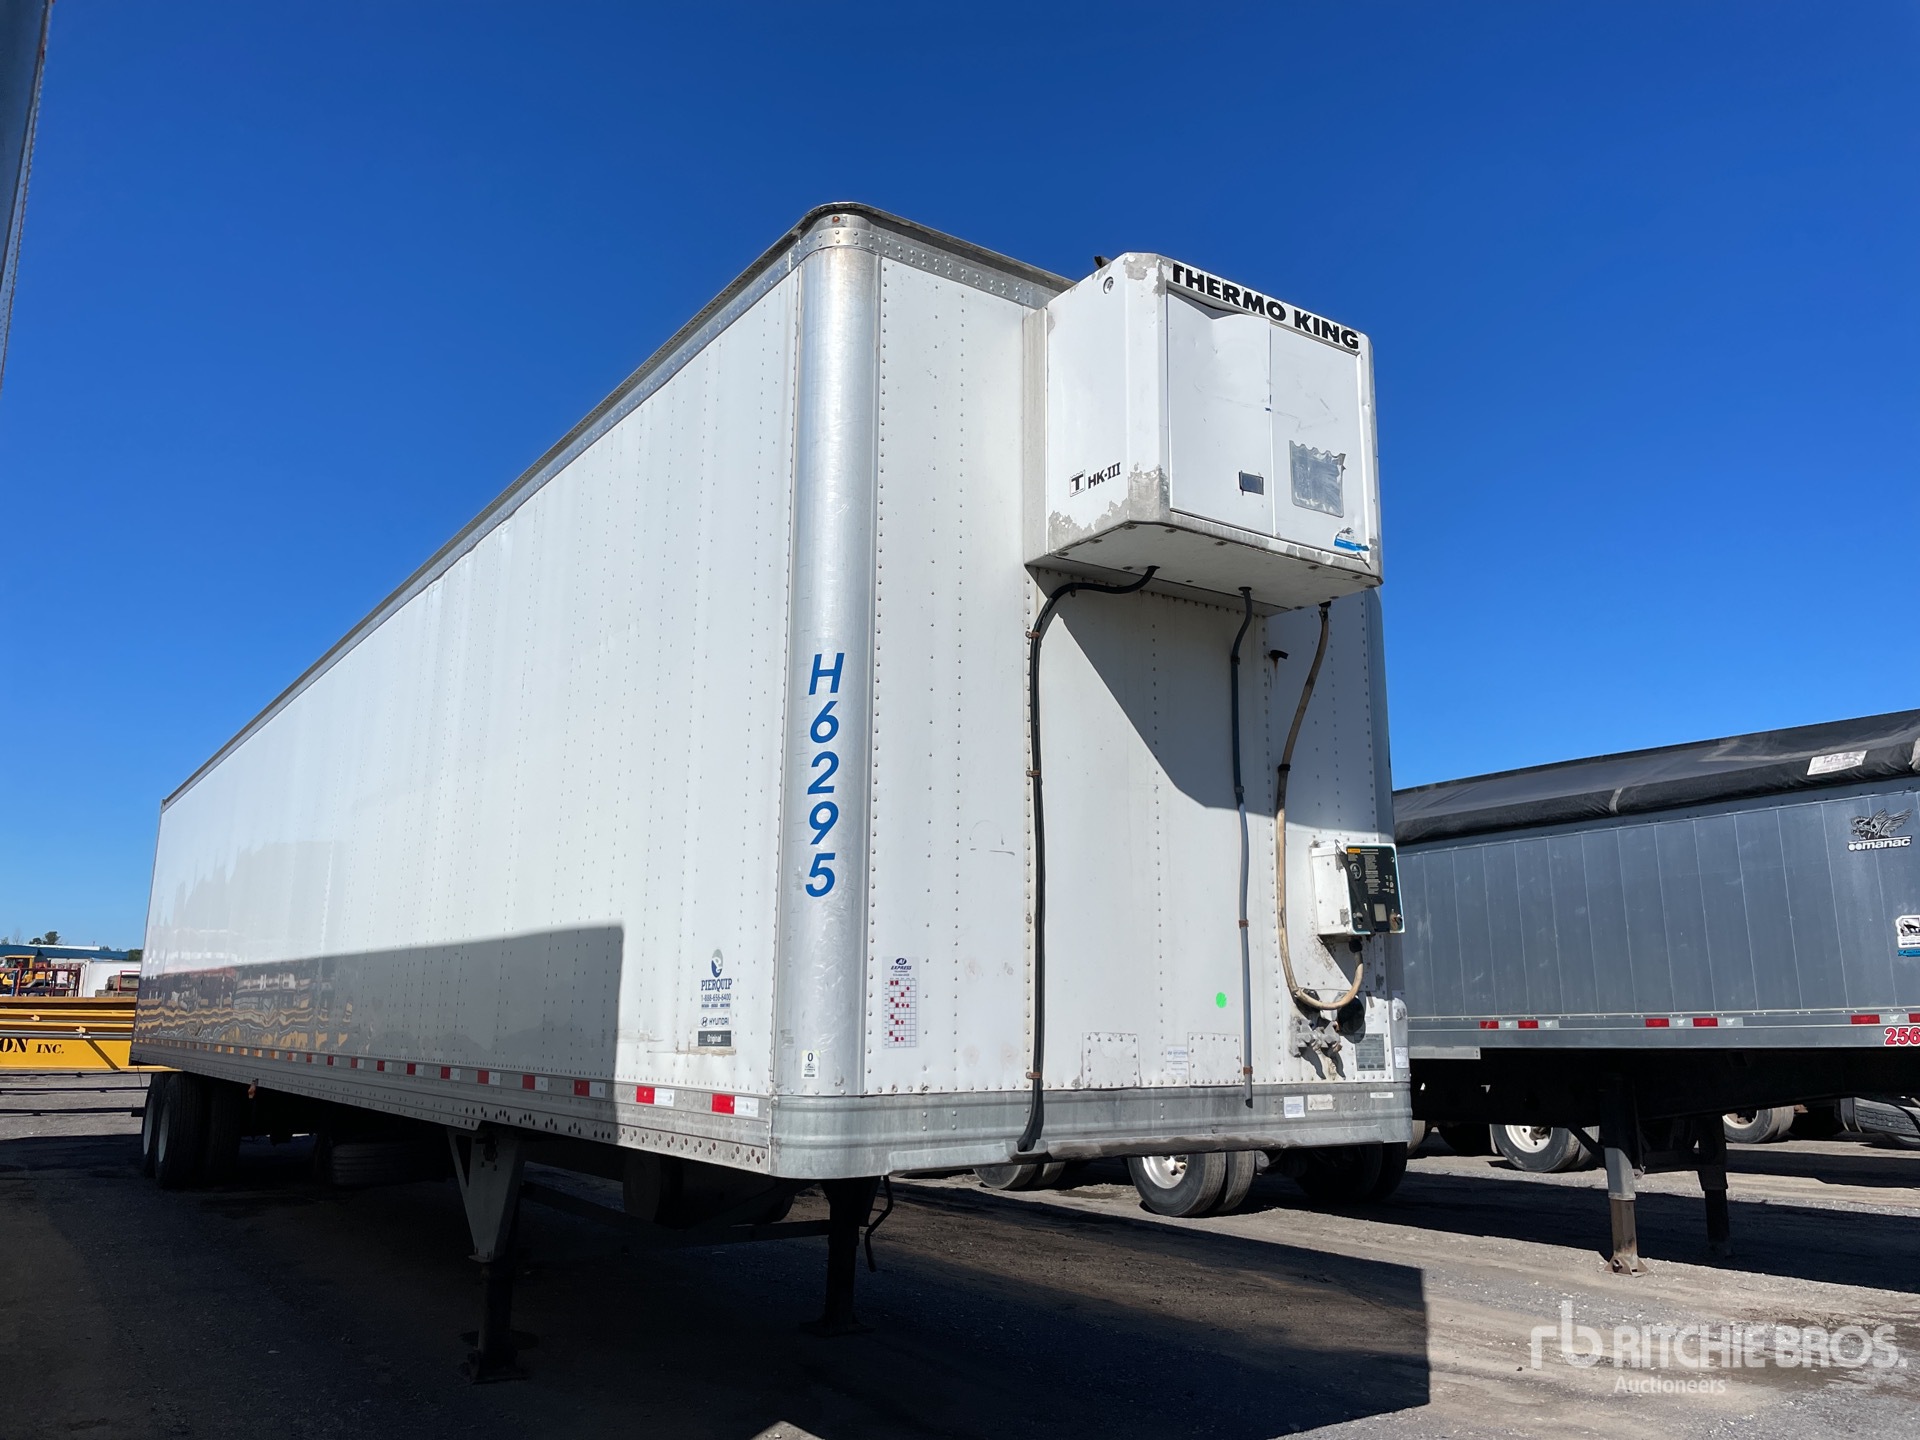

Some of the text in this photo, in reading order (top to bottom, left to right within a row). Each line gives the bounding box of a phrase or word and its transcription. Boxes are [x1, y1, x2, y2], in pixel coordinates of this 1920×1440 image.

[1173, 263, 1359, 350] THERMO KING
[805, 652, 845, 898] H6295
[701, 978, 733, 992] PIERQUIP
[36, 1043, 64, 1054] INC.
